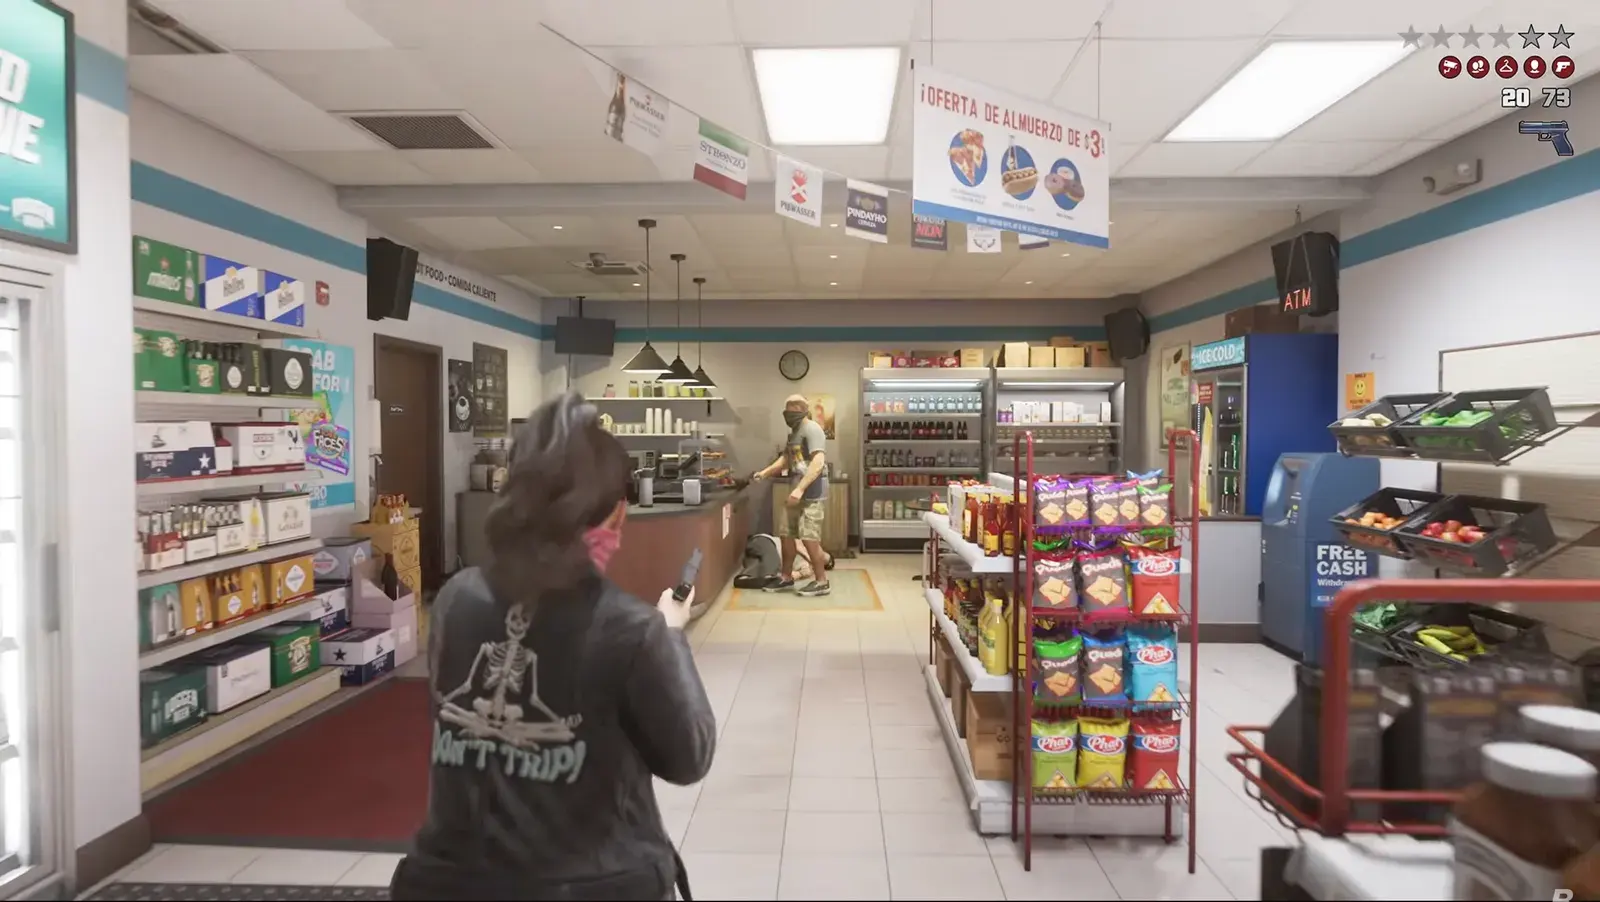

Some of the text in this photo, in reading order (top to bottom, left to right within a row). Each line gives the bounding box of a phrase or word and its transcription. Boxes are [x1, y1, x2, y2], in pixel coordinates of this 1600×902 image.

[984, 102, 999, 124] DE
[1002, 109, 1063, 143] ALMUERZO
[1067, 127, 1080, 147] DE
[847, 207, 887, 224] PINDAYHO
[425, 265, 444, 282] FOOD
[448, 274, 472, 293] COMIDA
[472, 284, 497, 303] CALIENTE
[1284, 287, 1311, 312] ATM
[1212, 344, 1236, 362] COLD
[1317, 545, 1367, 560] FREE
[1317, 561, 1367, 576] CASH
[1041, 737, 1068, 748] Phat
[1090, 736, 1119, 749] Phat
[1145, 736, 1174, 748] Phat
